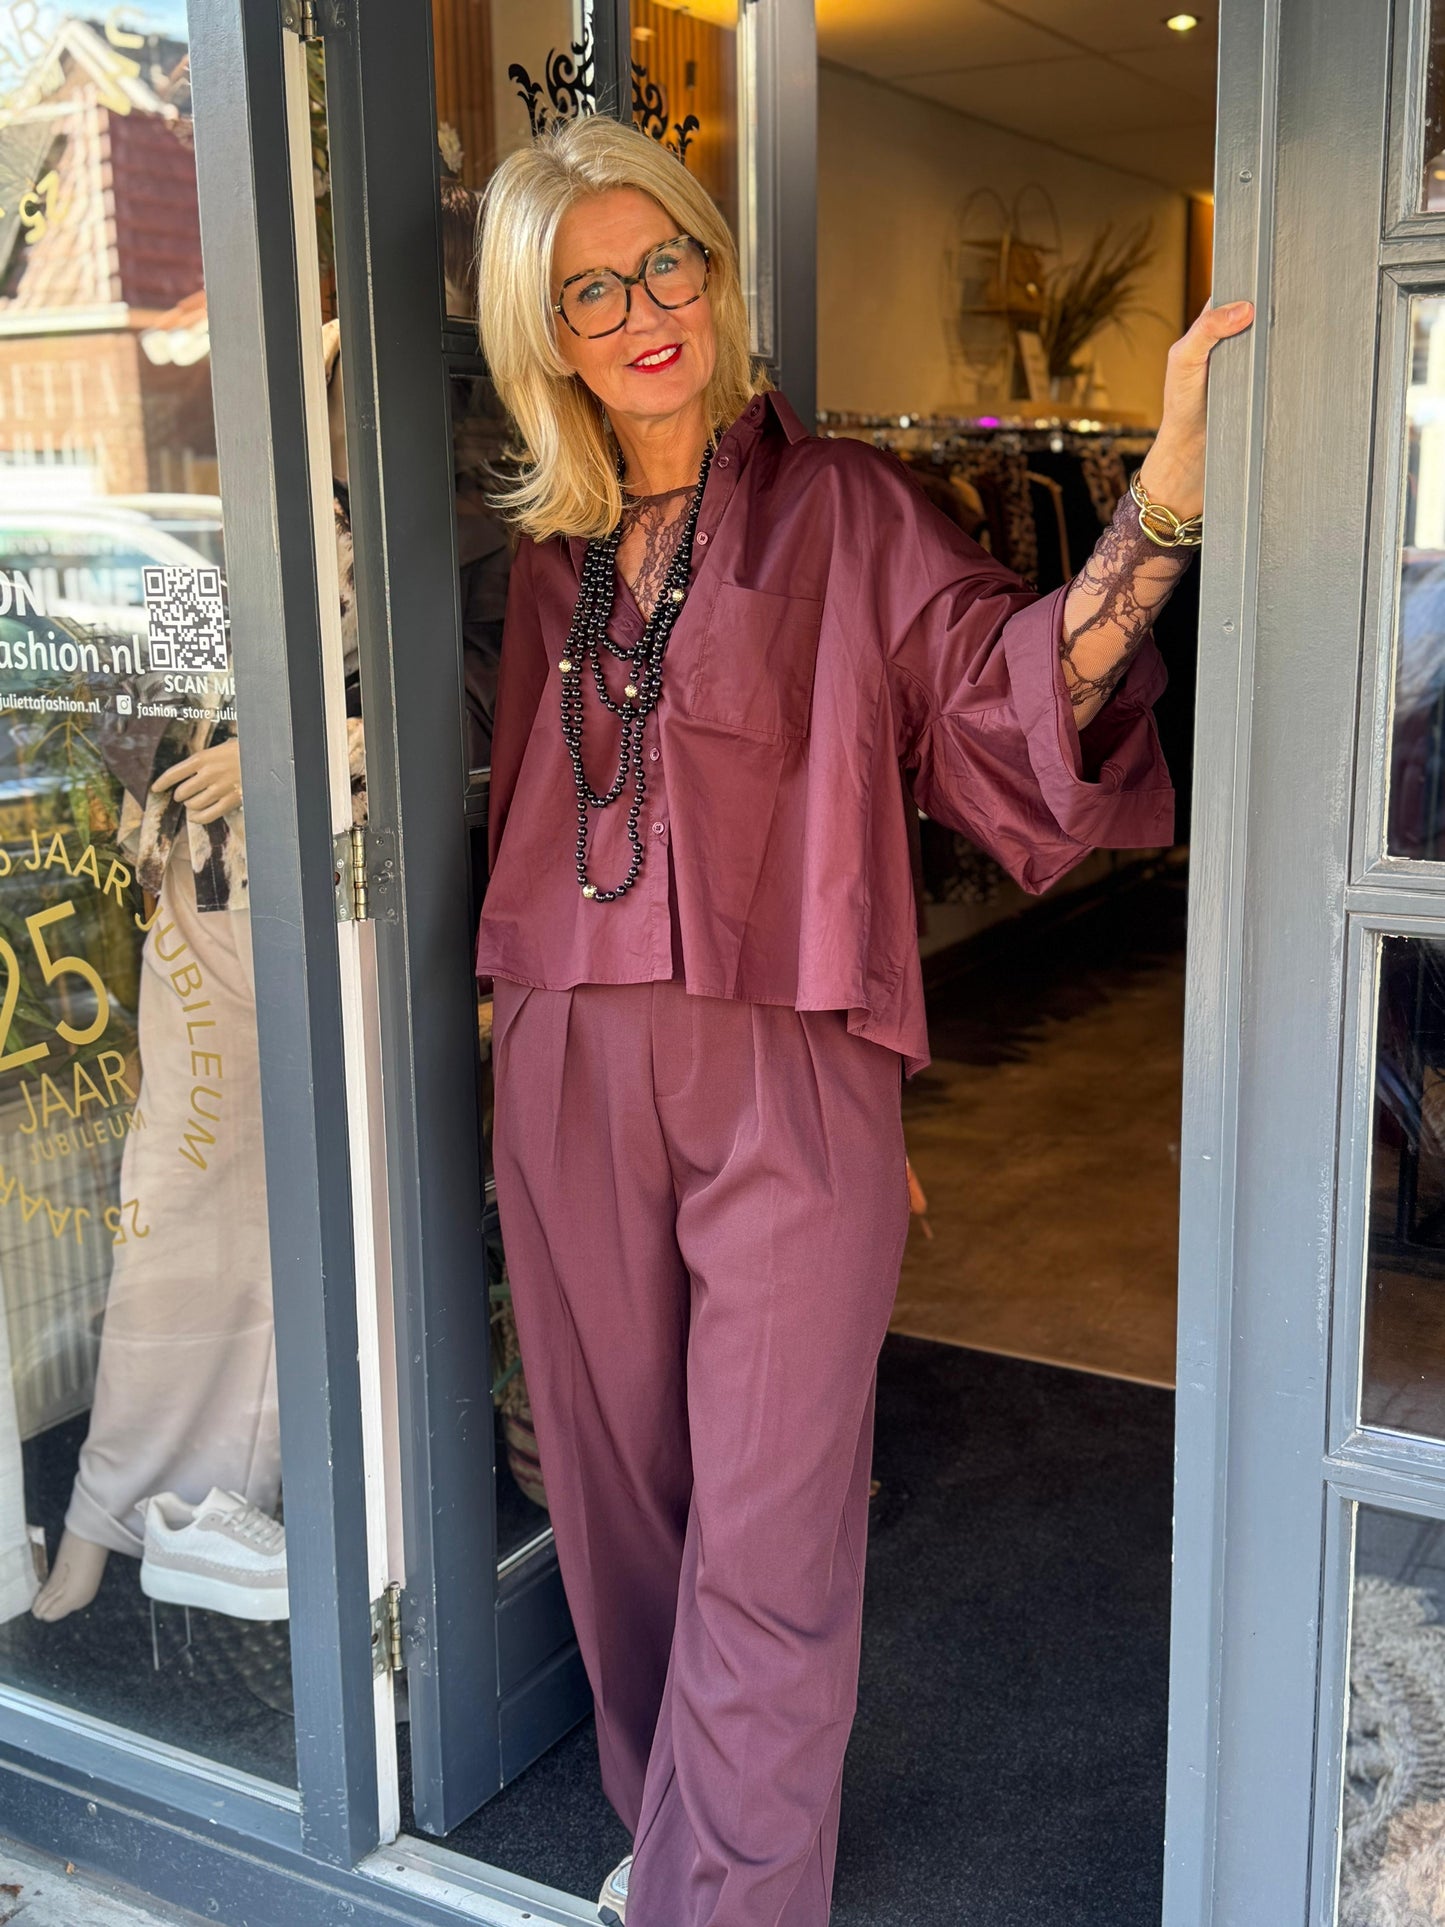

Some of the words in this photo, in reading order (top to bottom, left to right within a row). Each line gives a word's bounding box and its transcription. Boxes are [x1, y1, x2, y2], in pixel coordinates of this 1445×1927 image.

[164, 674, 208, 694] SCAN
[24, 829, 131, 908] JAAR
[0, 900, 109, 1073] 25
[134, 905, 224, 1171] JUBILEUM
[19, 1050, 137, 1135] JAAR
[31, 1108, 147, 1165] JUBILEUM
[104, 1198, 150, 1246] 25
